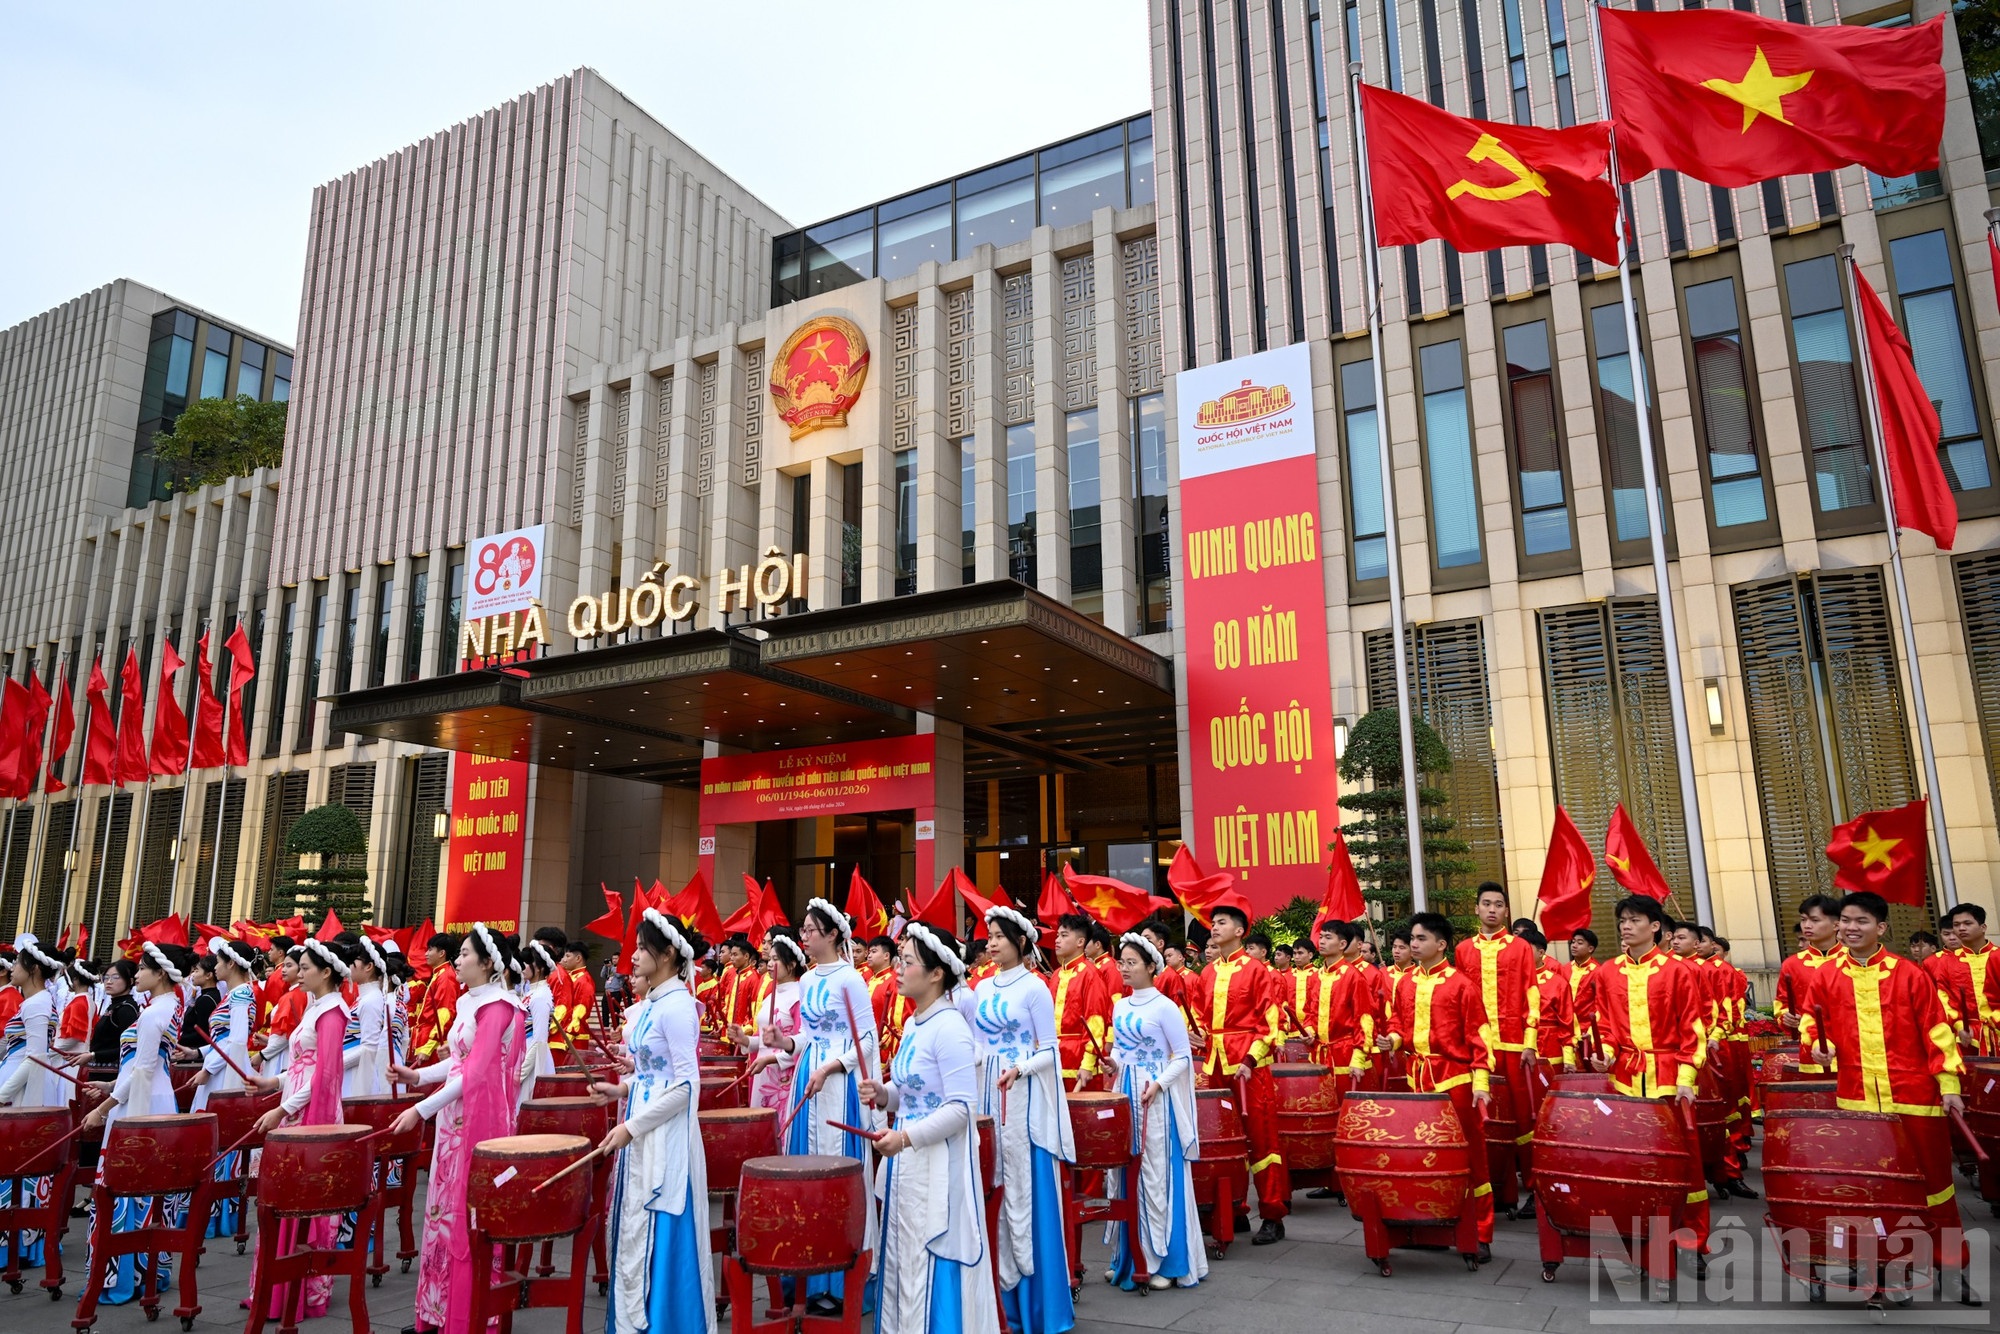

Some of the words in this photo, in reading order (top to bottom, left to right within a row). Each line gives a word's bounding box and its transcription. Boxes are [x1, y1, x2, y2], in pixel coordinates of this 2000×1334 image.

[1197, 431, 1224, 445] QUỐC
[1226, 428, 1243, 440] HỘI
[1245, 422, 1267, 435] VIỆT
[1269, 418, 1293, 430] NAM
[1198, 443, 1225, 452] NATIONAL
[1226, 436, 1255, 446] ASSEMBLY
[1189, 524, 1237, 580] VINH
[1244, 511, 1316, 575] QUANG
[461, 597, 552, 660] NHÀ
[567, 561, 701, 640] QUỐC
[719, 545, 809, 616] HỘI
[1213, 619, 1241, 672] 80
[1249, 606, 1299, 667] NĂM
[1210, 696, 1268, 772] QUỐC
[1275, 705, 1313, 775] HỘI
[779, 755, 794, 769] LỄ
[815, 752, 847, 766] NIỆM
[469, 776, 488, 801] ĐẦU
[489, 776, 509, 798] TIÊN
[704, 784, 714, 795] 80
[714, 781, 731, 794] NĂM
[732, 779, 752, 792] NGÀY
[752, 775, 771, 790] TỔNG
[823, 770, 839, 783] TIÊN
[856, 765, 877, 781] QUỐC
[878, 764, 892, 780] HỘI
[893, 763, 910, 778] VIỆT
[910, 762, 931, 775] NAM
[756, 784, 870, 804] (06/01/1946-06/01/2026)
[456, 812, 474, 837] BẦU
[476, 810, 500, 837] QUỐC
[502, 810, 519, 837] HỘI
[1214, 805, 1258, 881] VIỆT
[1269, 809, 1320, 865] NAM
[463, 850, 483, 876] VIỆT
[484, 851, 507, 871] NAM
